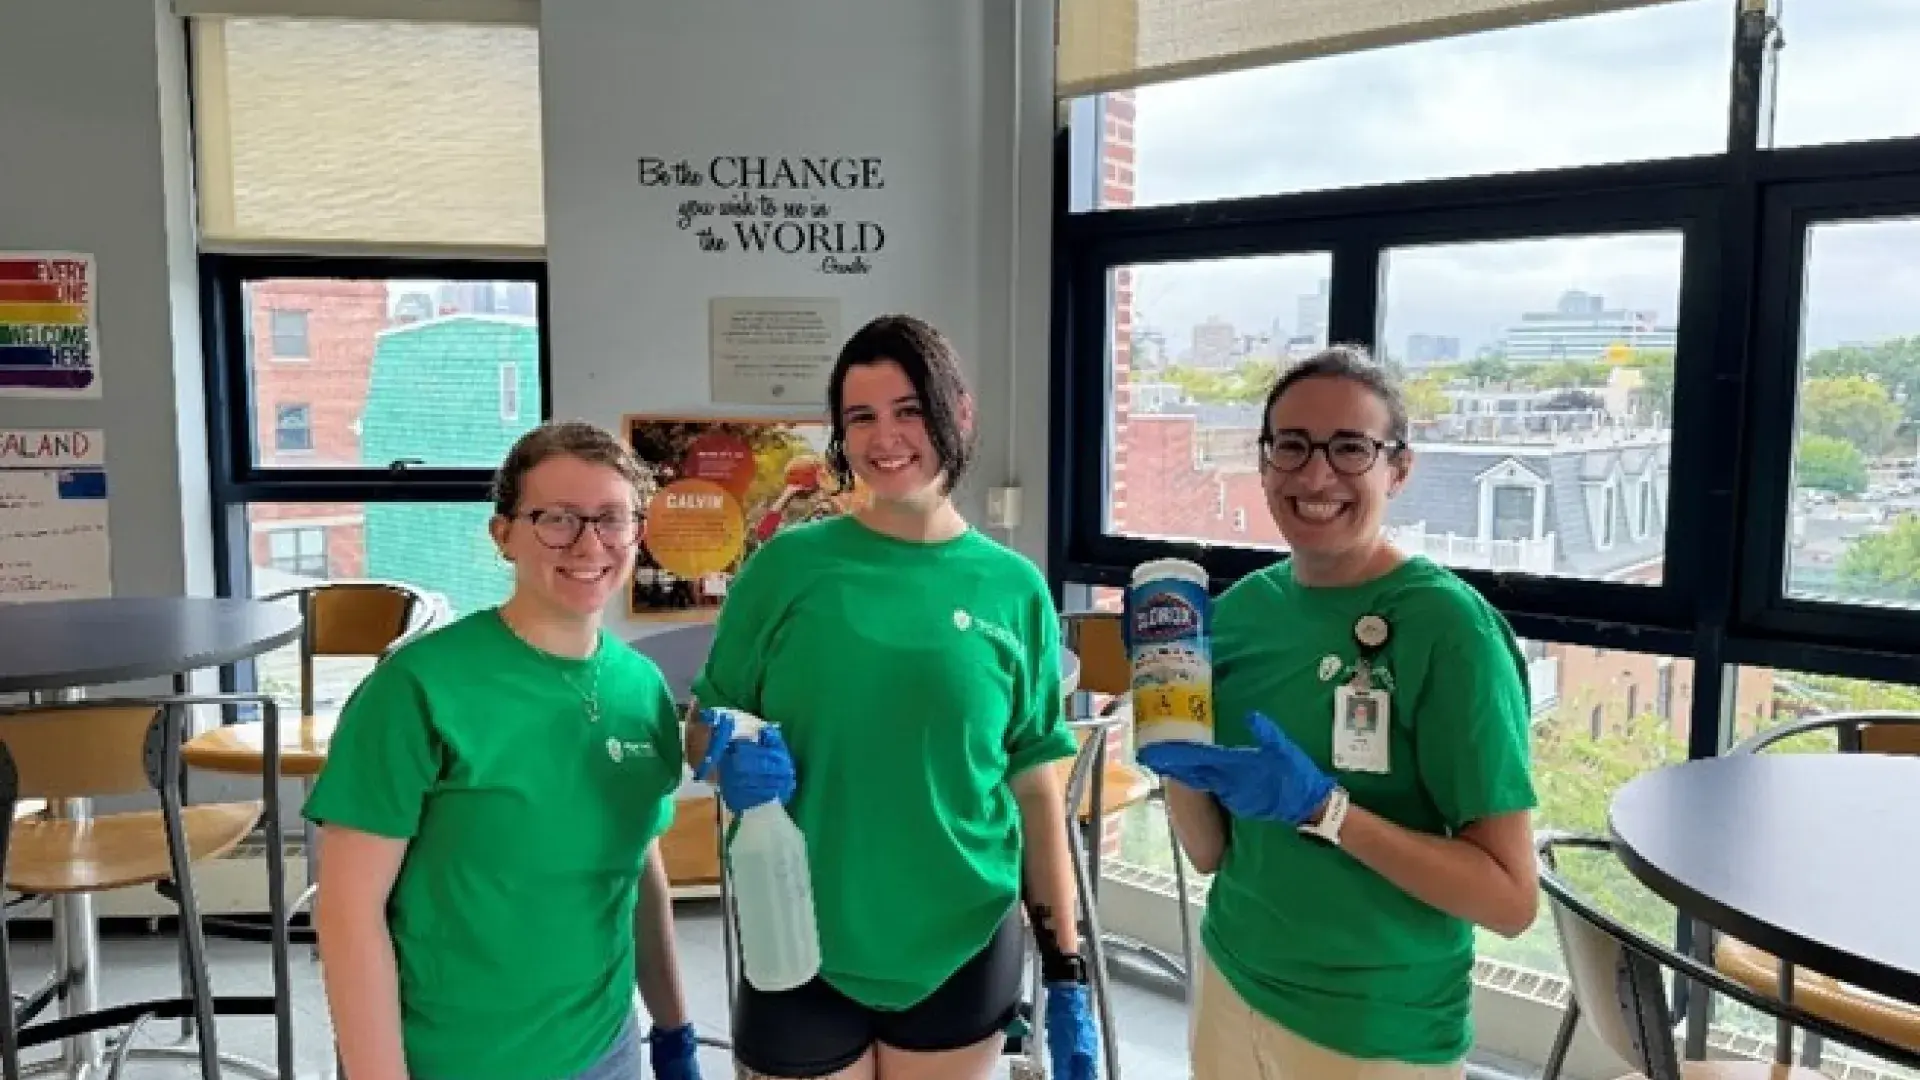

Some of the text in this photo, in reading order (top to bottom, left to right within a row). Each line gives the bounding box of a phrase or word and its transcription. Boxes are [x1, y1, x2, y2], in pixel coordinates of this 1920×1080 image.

[637, 155, 885, 190] Be the CHANGE
[676, 200, 715, 230] you
[719, 192, 756, 217] wish
[756, 194, 777, 218] to
[694, 220, 885, 254] the WORLD
[37, 260, 88, 282] EVERY
[57, 283, 88, 304] ONE
[8, 324, 90, 346] WELCOME
[50, 346, 92, 368] HERE
[0, 432, 89, 458] ALAND
